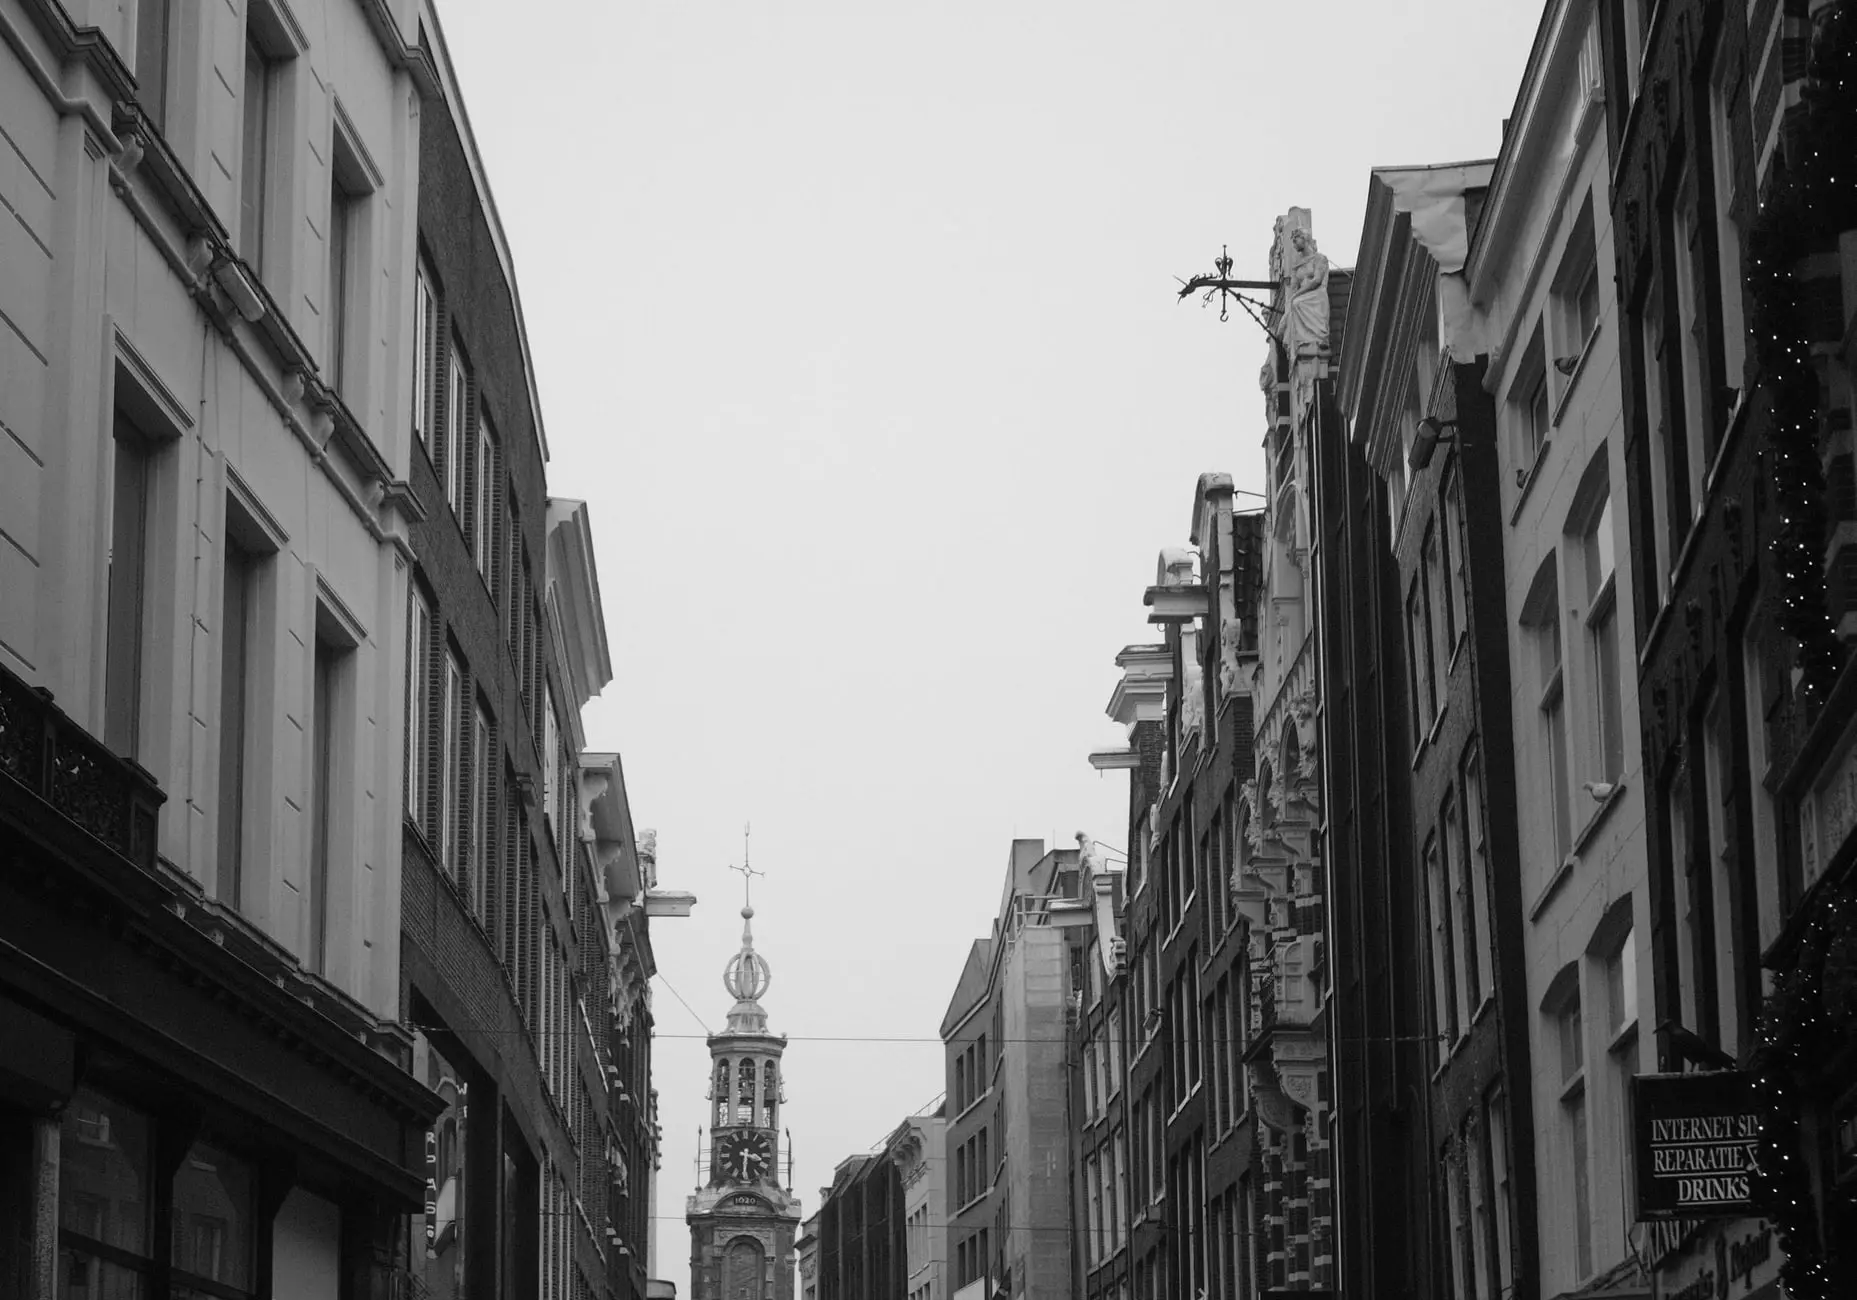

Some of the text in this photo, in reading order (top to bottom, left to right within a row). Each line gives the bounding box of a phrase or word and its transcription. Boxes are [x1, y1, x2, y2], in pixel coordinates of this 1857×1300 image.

[1651, 1115, 1735, 1141] INTERNET
[1653, 1146, 1744, 1172] REPARATIE
[1677, 1176, 1751, 1201] DRINKS
